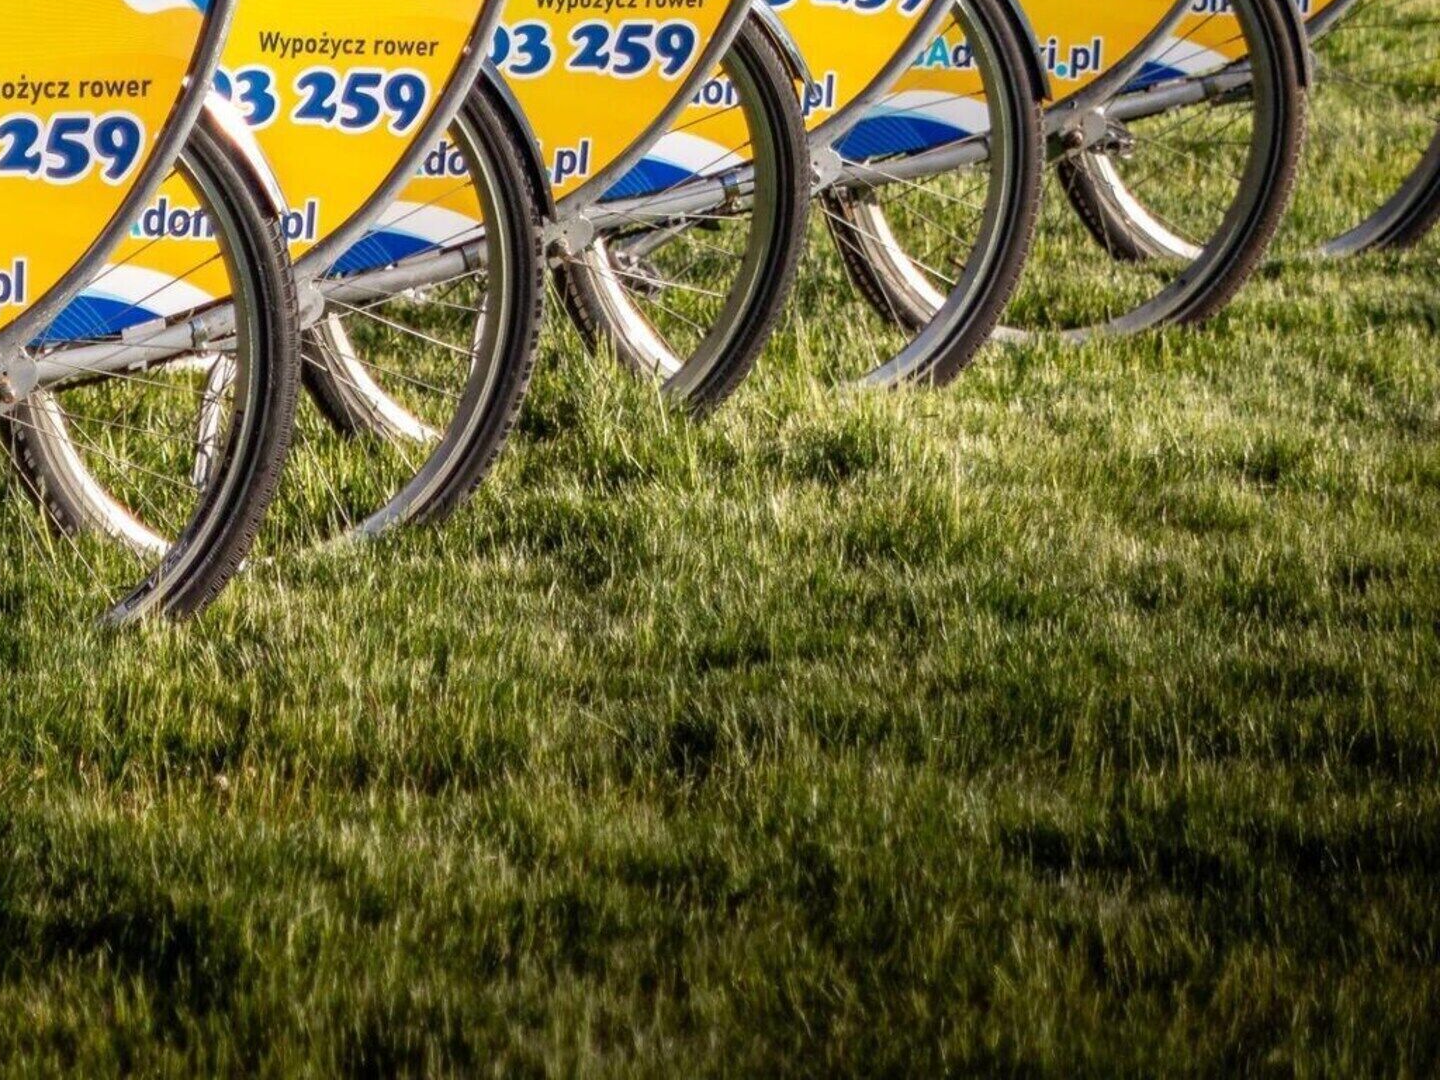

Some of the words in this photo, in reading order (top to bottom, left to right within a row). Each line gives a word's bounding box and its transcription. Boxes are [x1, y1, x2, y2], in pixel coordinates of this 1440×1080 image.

[259, 30, 365, 60] Wypożycz
[373, 39, 439, 57] rower
[568, 22, 697, 76] 259
[78, 78, 153, 98] rower
[293, 70, 428, 133] 259
